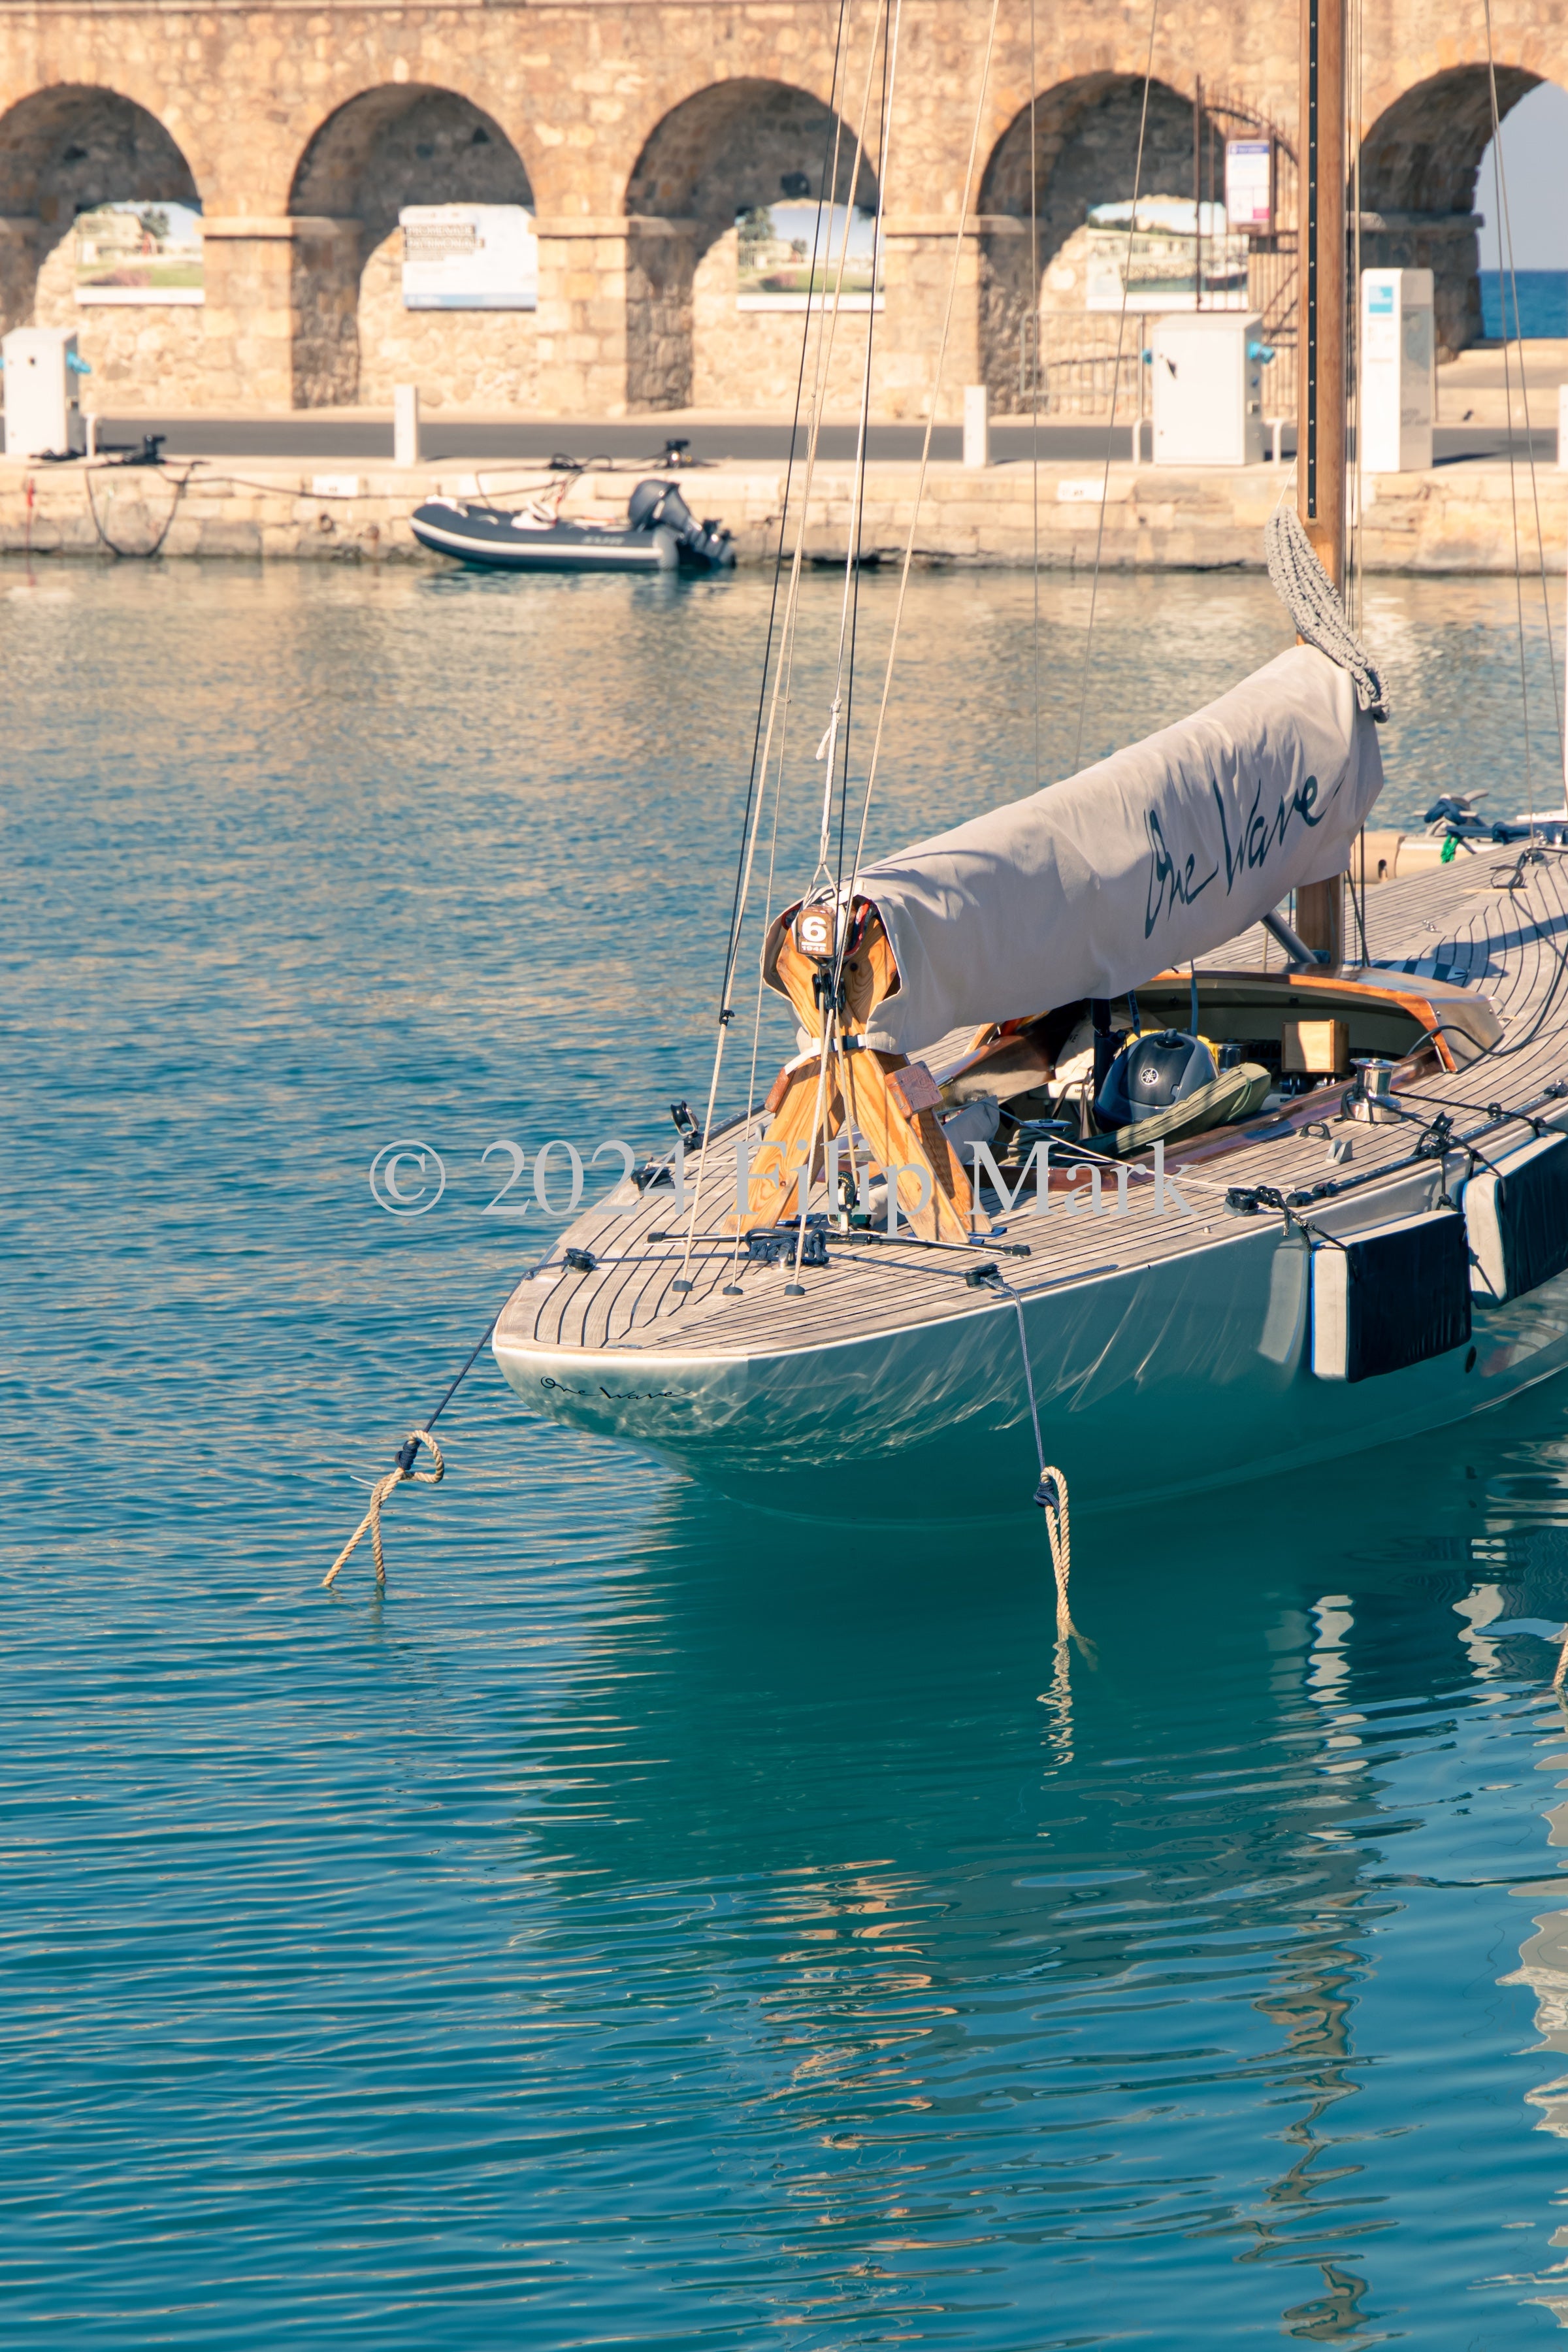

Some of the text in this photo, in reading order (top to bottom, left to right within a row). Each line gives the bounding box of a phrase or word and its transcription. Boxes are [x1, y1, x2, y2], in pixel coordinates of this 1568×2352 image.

[1213, 775, 1347, 897] Wave
[802, 916, 827, 942] 6
[540, 1376, 691, 1400] One Wave
